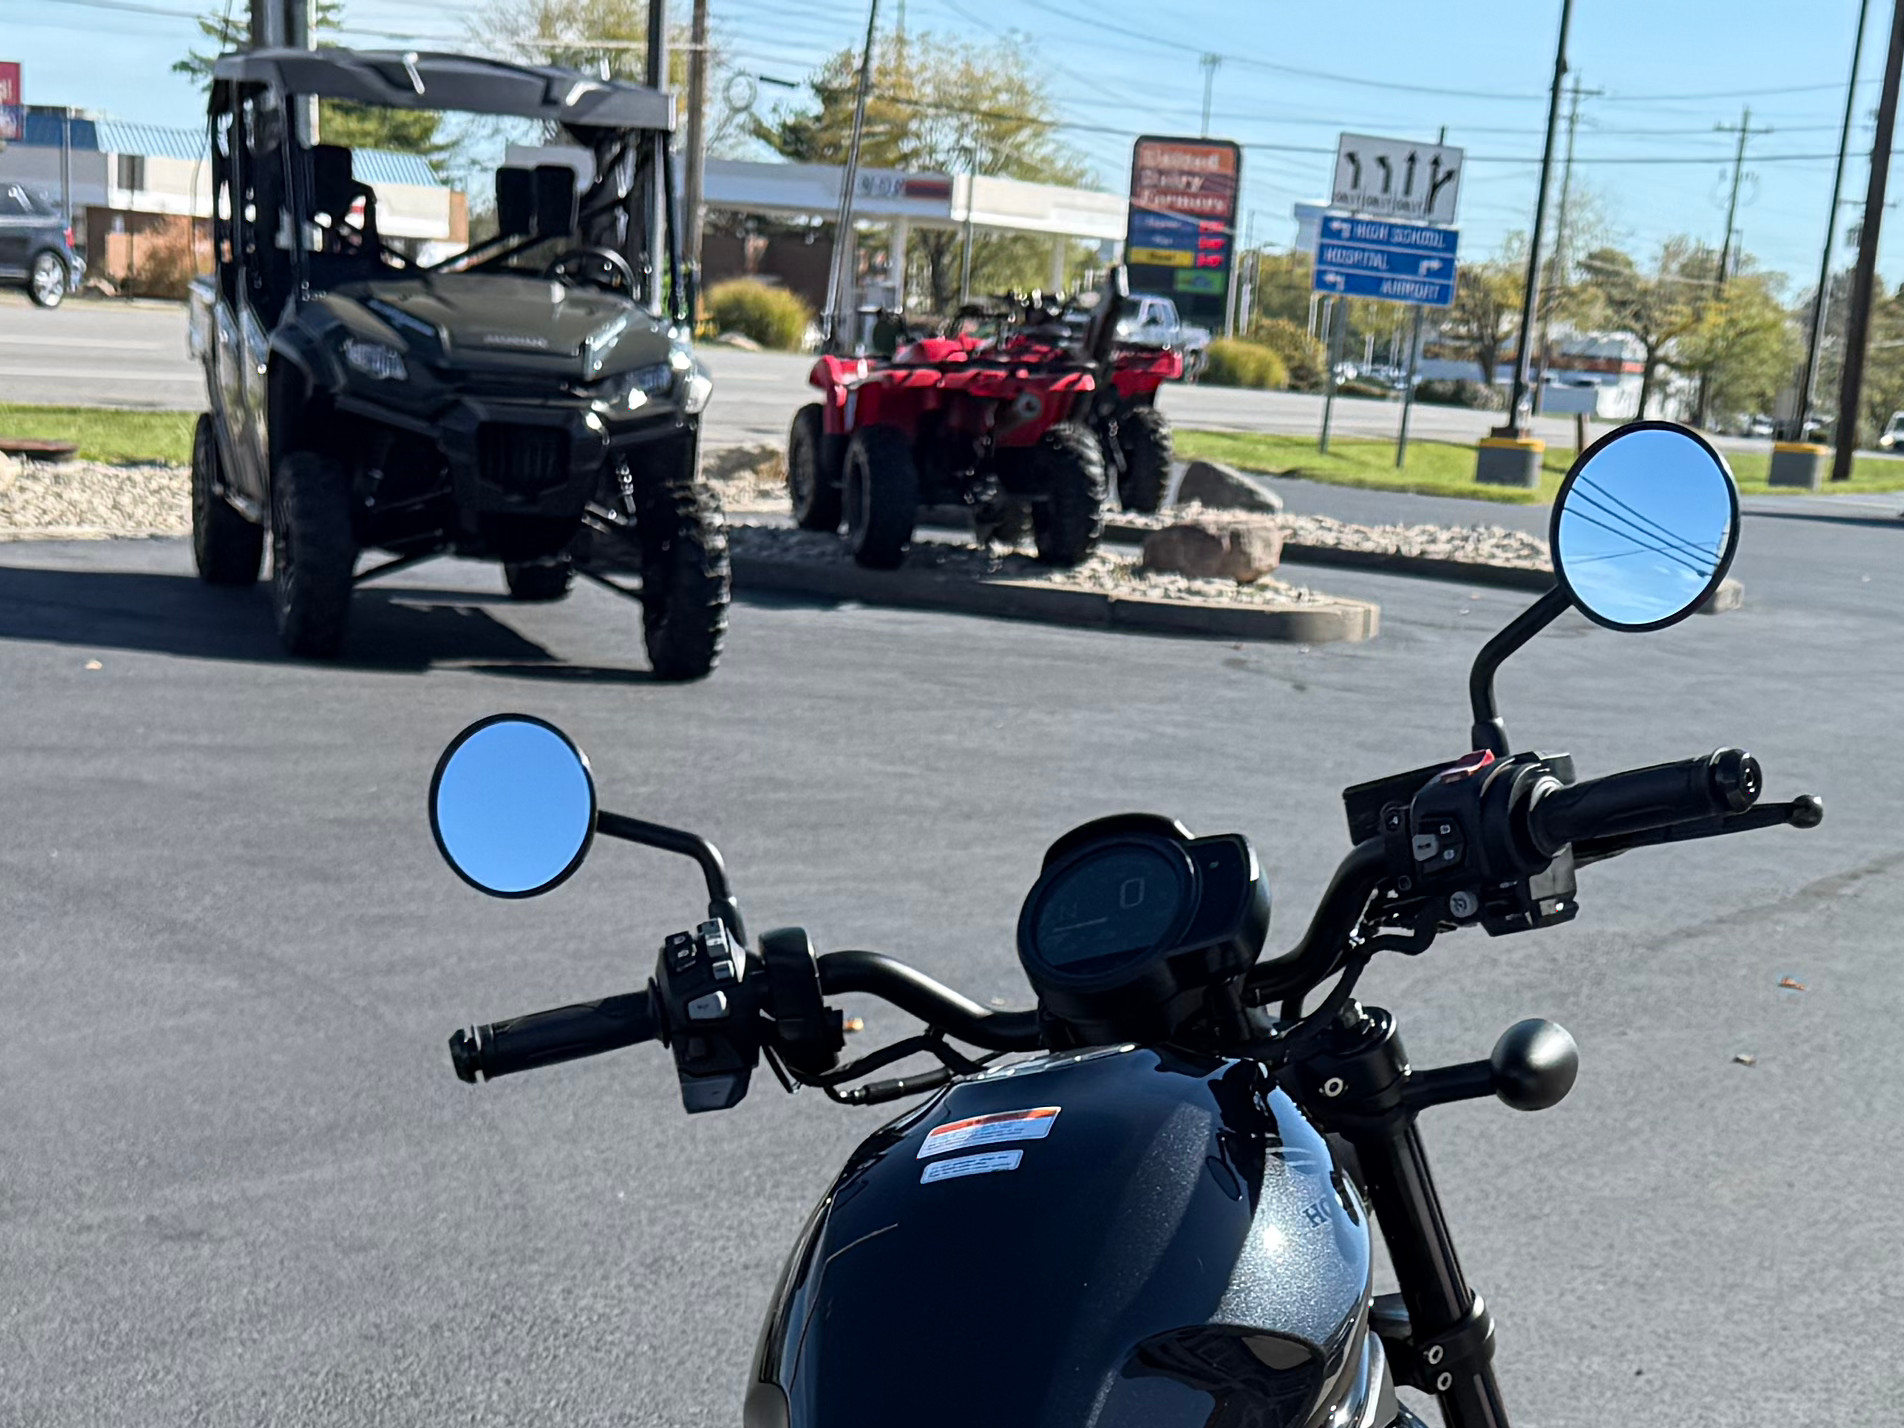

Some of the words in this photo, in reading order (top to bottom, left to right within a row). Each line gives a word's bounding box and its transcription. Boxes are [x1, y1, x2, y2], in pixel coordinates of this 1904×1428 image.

[1390, 227, 1445, 248] SCHOOL
[1323, 248, 1389, 270] HOSPITAL
[1381, 279, 1440, 299] AIRPORT
